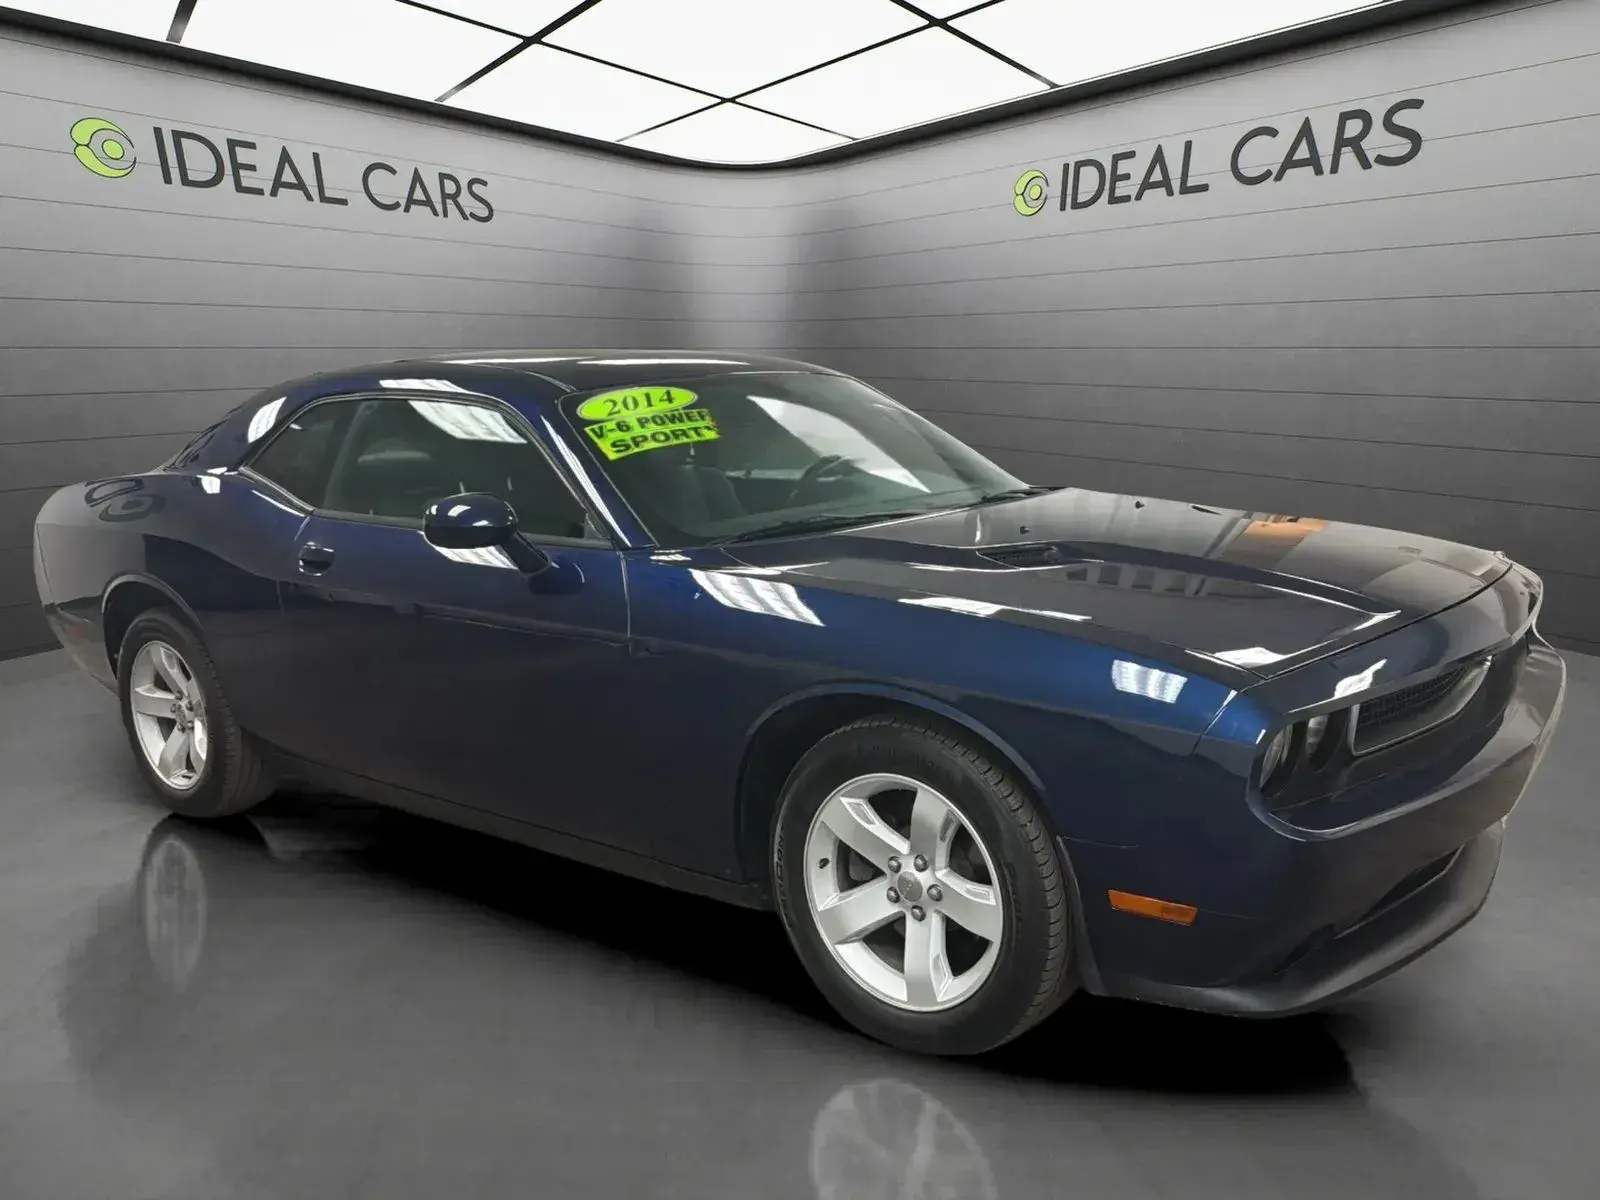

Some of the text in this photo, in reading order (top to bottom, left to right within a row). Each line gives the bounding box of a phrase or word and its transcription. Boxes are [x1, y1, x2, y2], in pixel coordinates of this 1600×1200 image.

[153, 125, 495, 223] IDEAL CARS
[1059, 98, 1425, 213] IDEAL CARS
[590, 419, 631, 440] V-6
[602, 389, 675, 418] 2014
